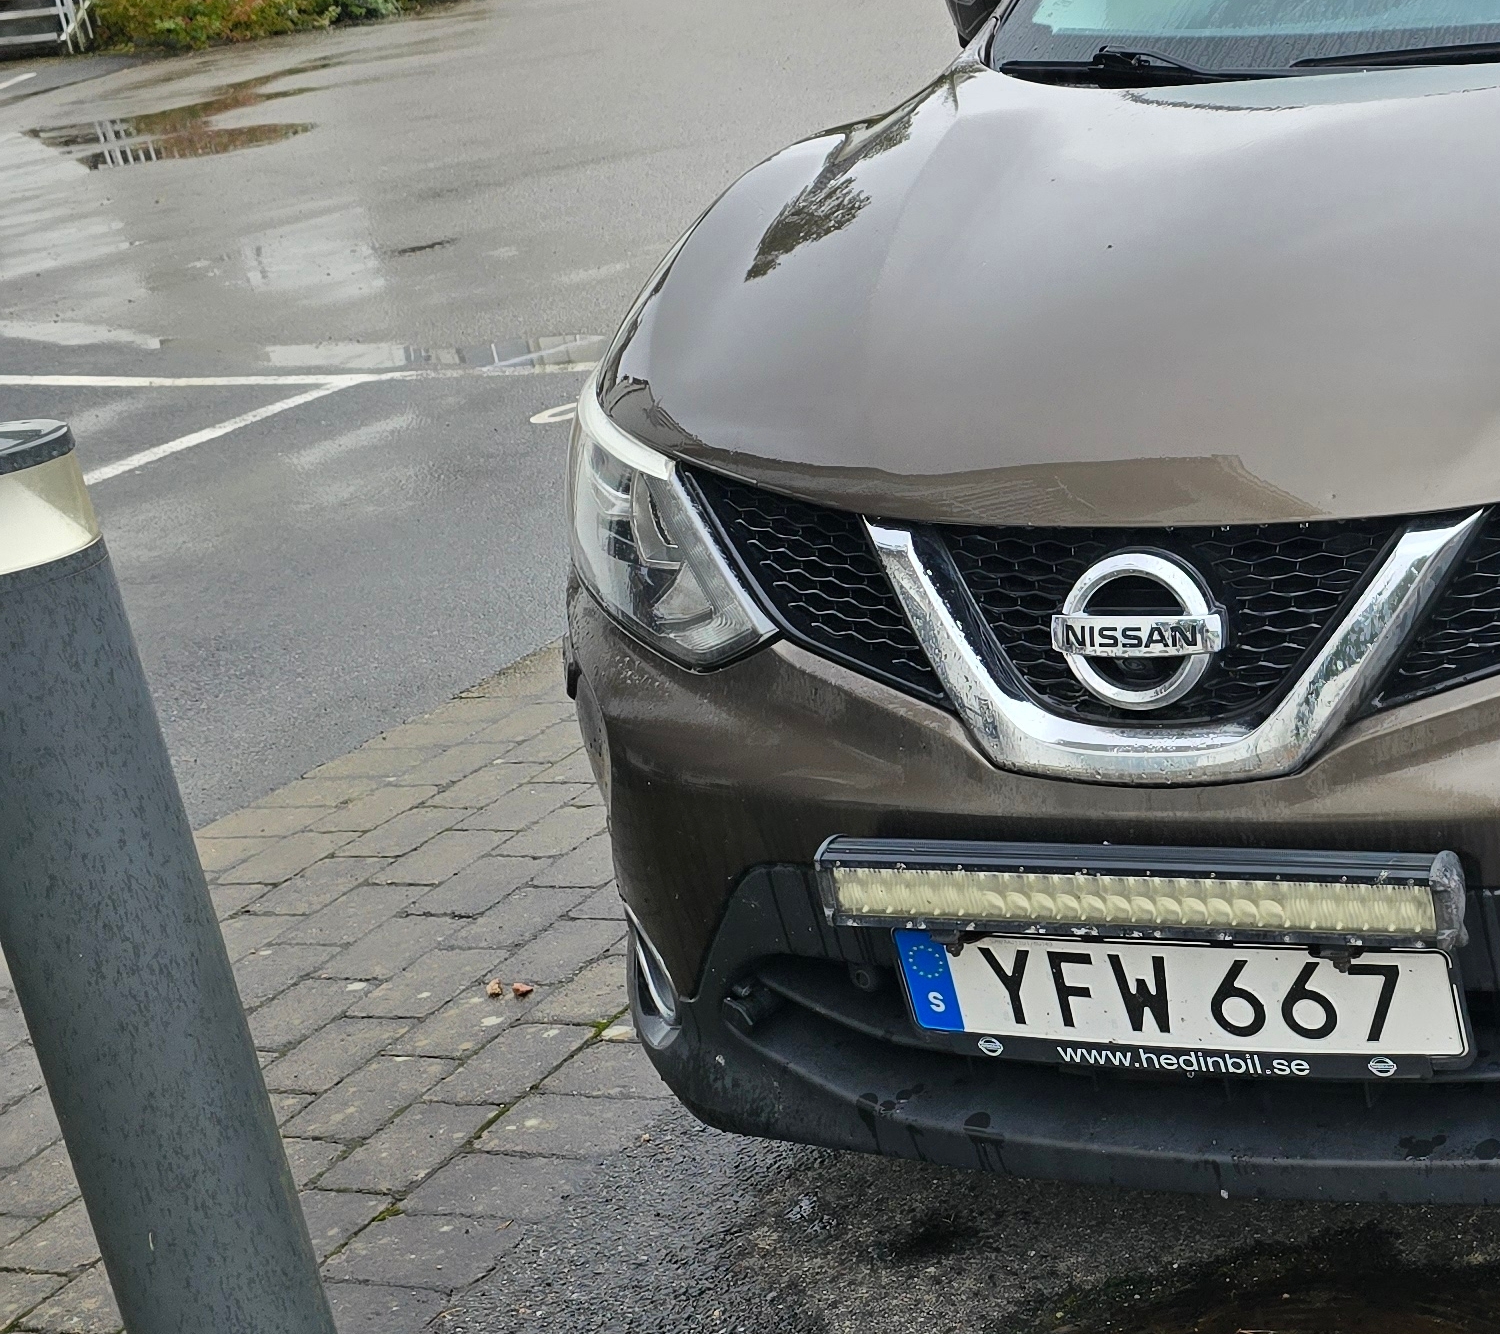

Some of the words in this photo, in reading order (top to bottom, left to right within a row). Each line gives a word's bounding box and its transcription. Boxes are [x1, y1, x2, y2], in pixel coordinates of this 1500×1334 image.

[1065, 623, 1198, 648] NISSAN
[929, 990, 946, 1013] S
[977, 946, 1171, 1033] YFW
[1210, 959, 1400, 1041] 667
[1057, 1046, 1310, 1075] www.hedinbil.se
